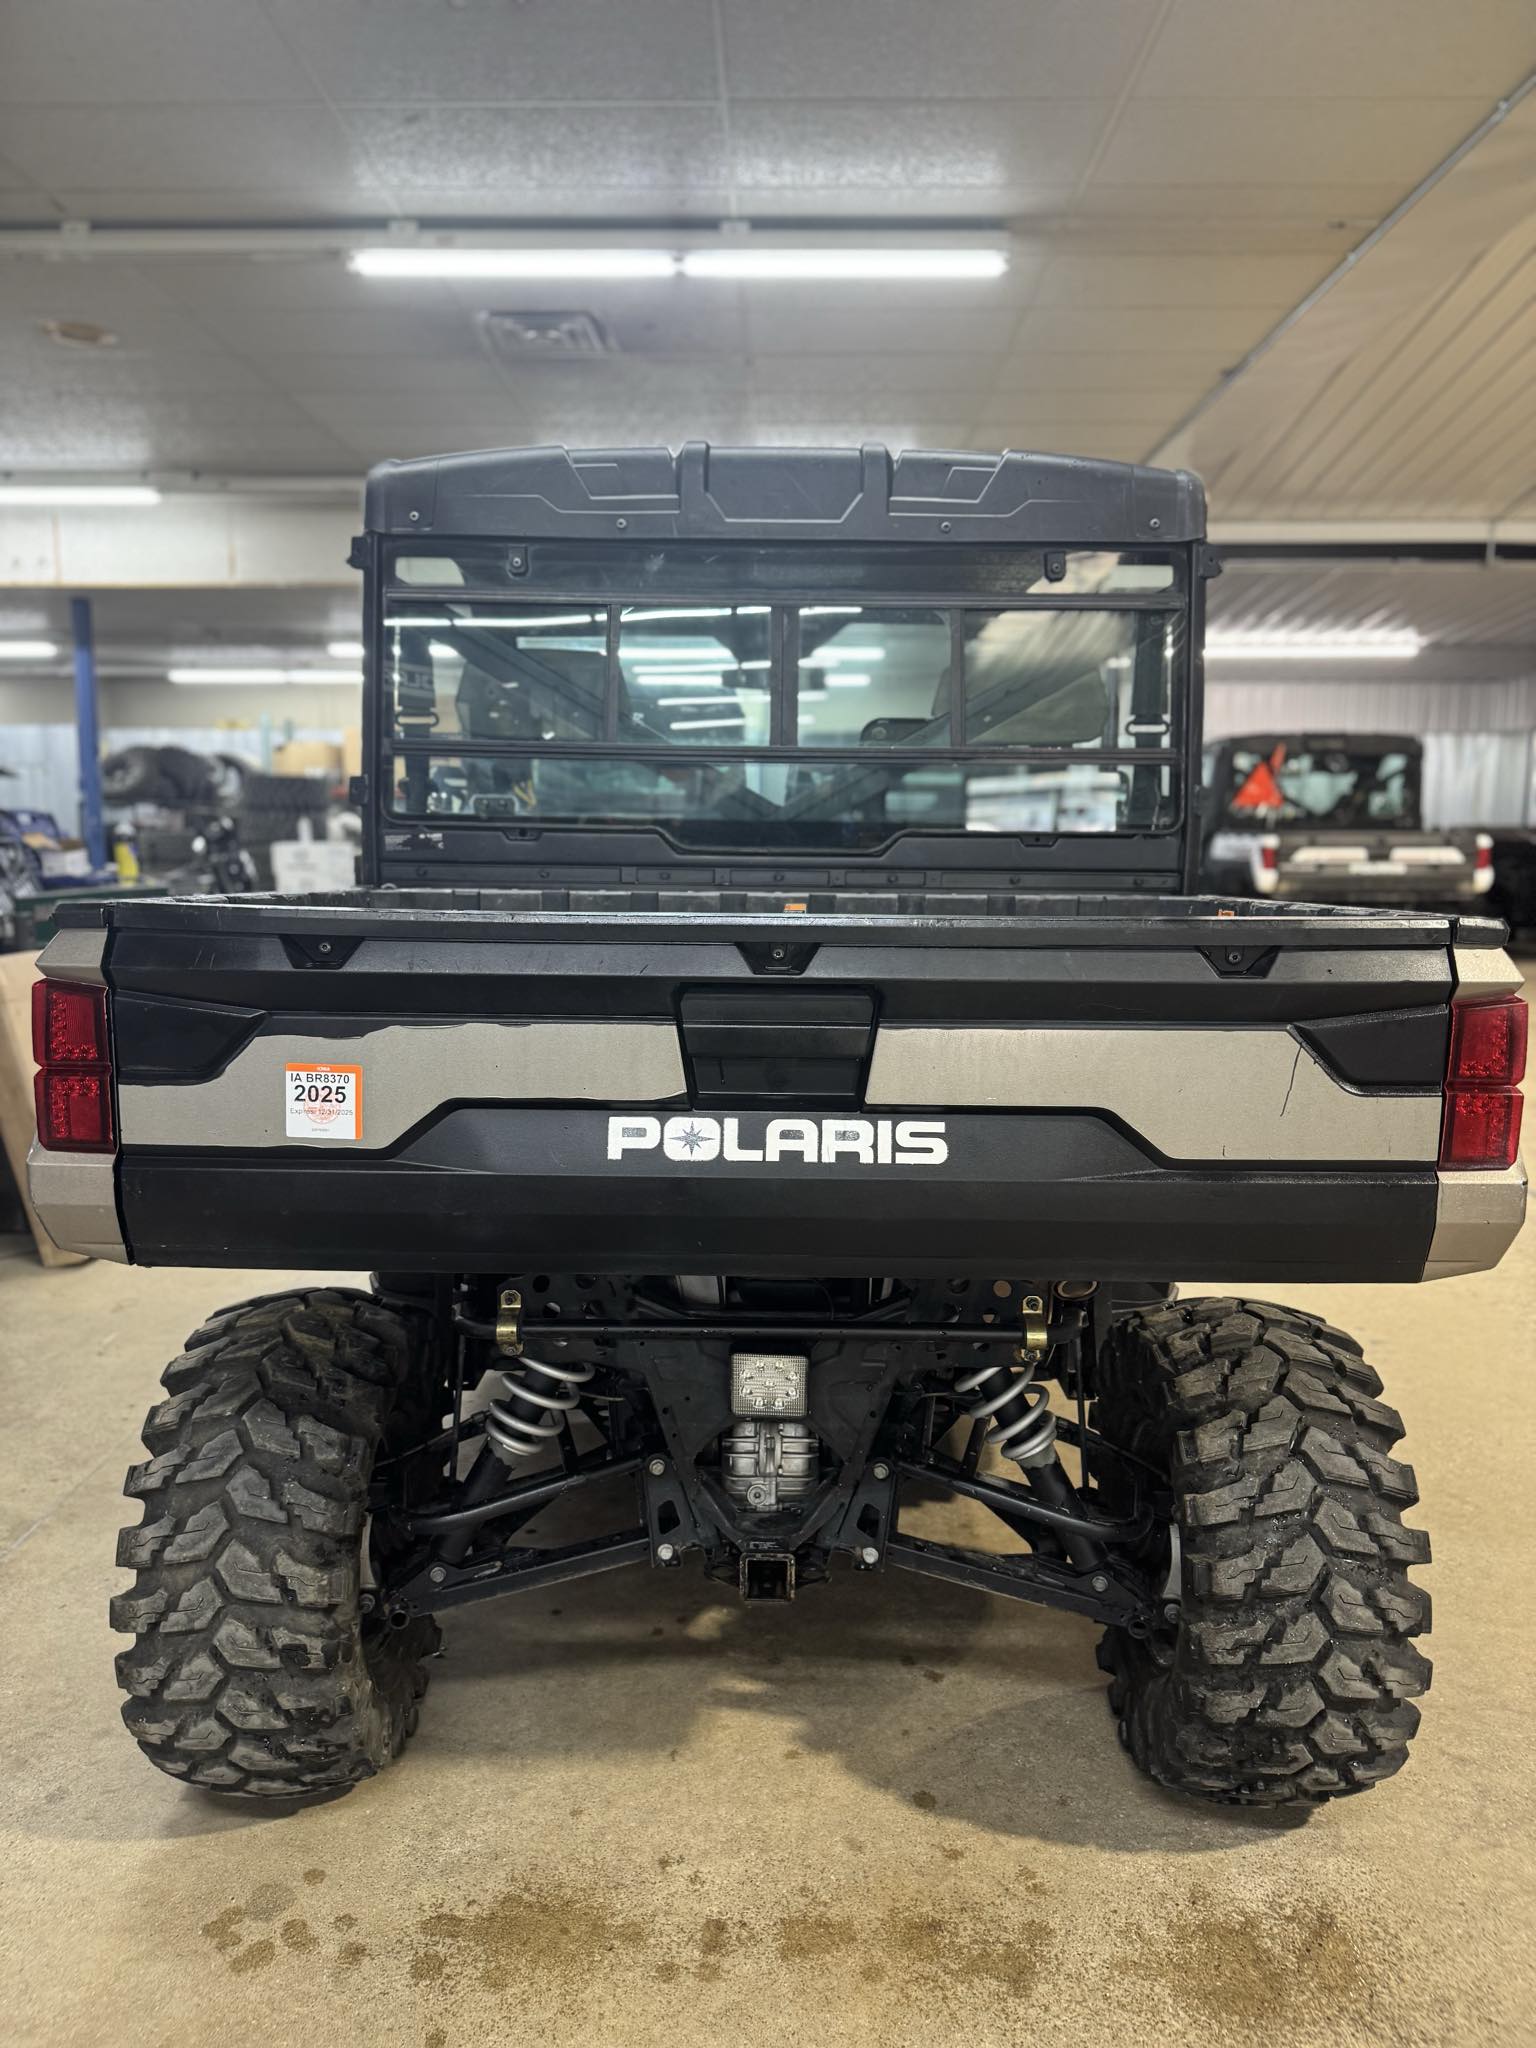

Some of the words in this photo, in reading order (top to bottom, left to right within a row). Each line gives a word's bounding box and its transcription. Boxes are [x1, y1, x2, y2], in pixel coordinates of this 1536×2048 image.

[290, 1073, 302, 1082] IA
[306, 1073, 350, 1084] BR8370
[294, 1085, 346, 1103] 2025
[607, 1116, 948, 1164] POLARIS
